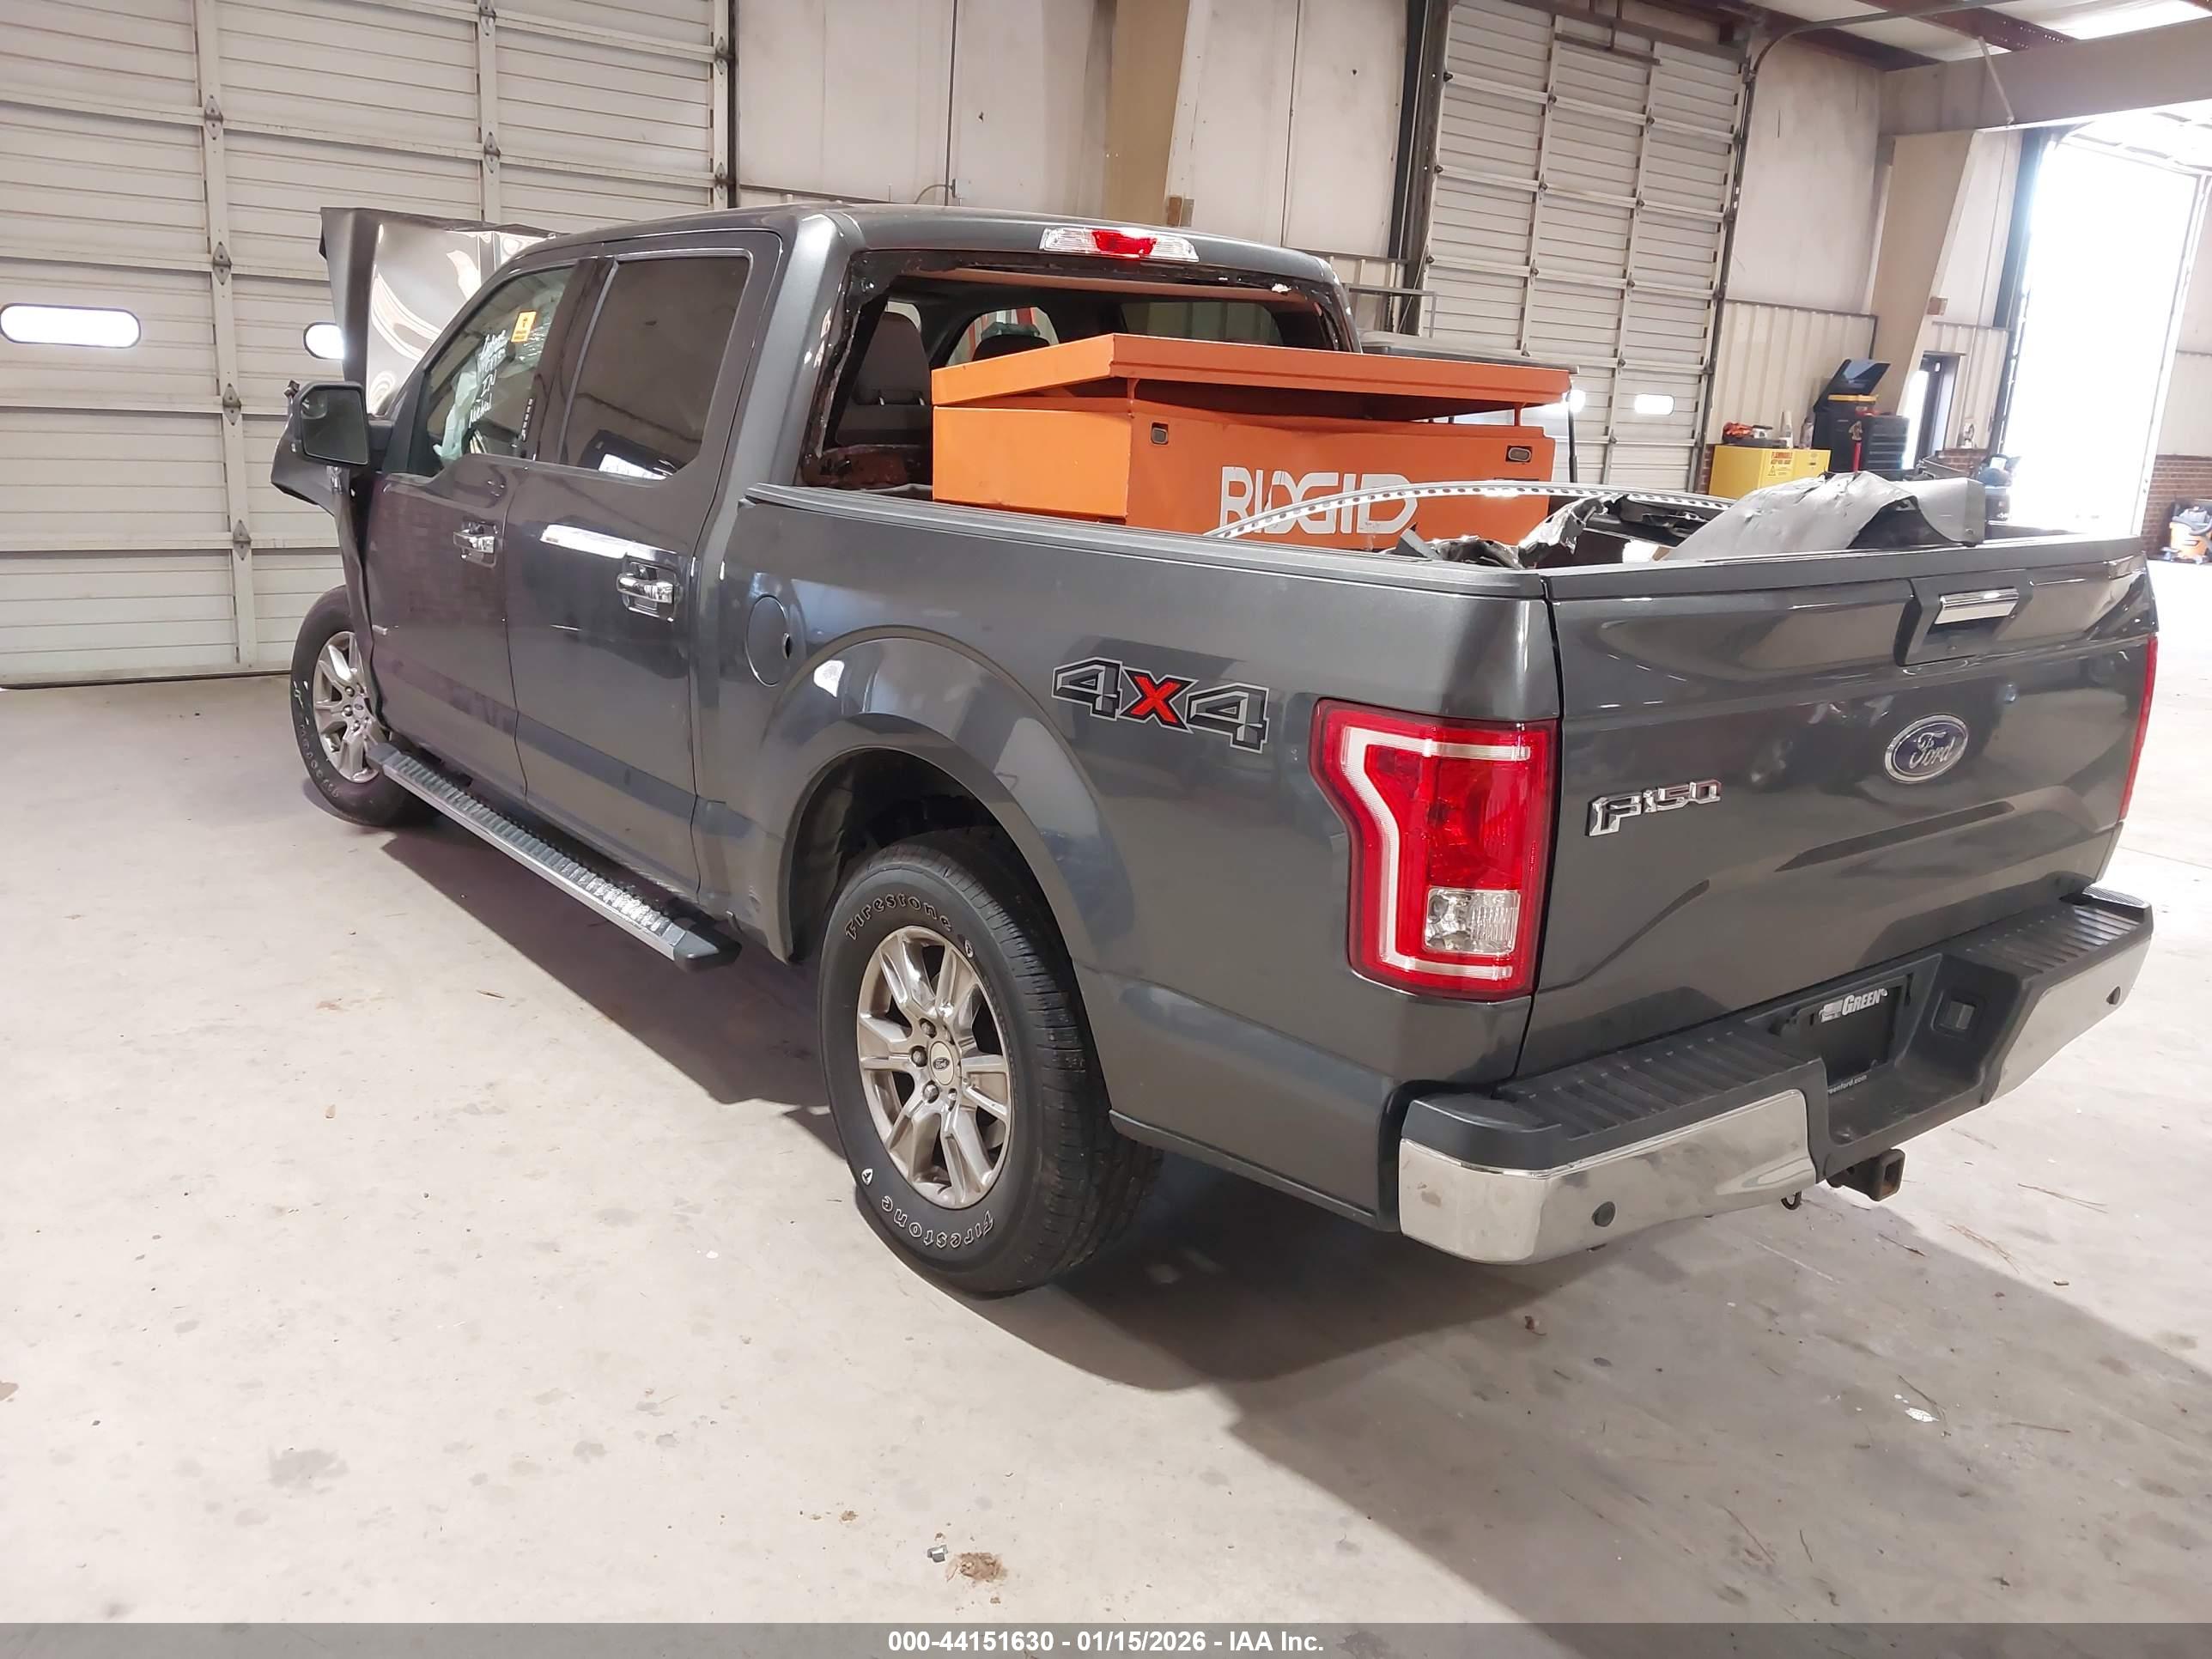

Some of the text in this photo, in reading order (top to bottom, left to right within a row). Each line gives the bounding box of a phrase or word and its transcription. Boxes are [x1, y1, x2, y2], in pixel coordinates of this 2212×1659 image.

[1219, 465, 1419, 535] RIDGID
[1909, 730, 1956, 769] Ford
[845, 893, 952, 941] Firestone
[881, 1195, 994, 1249] Firestone
